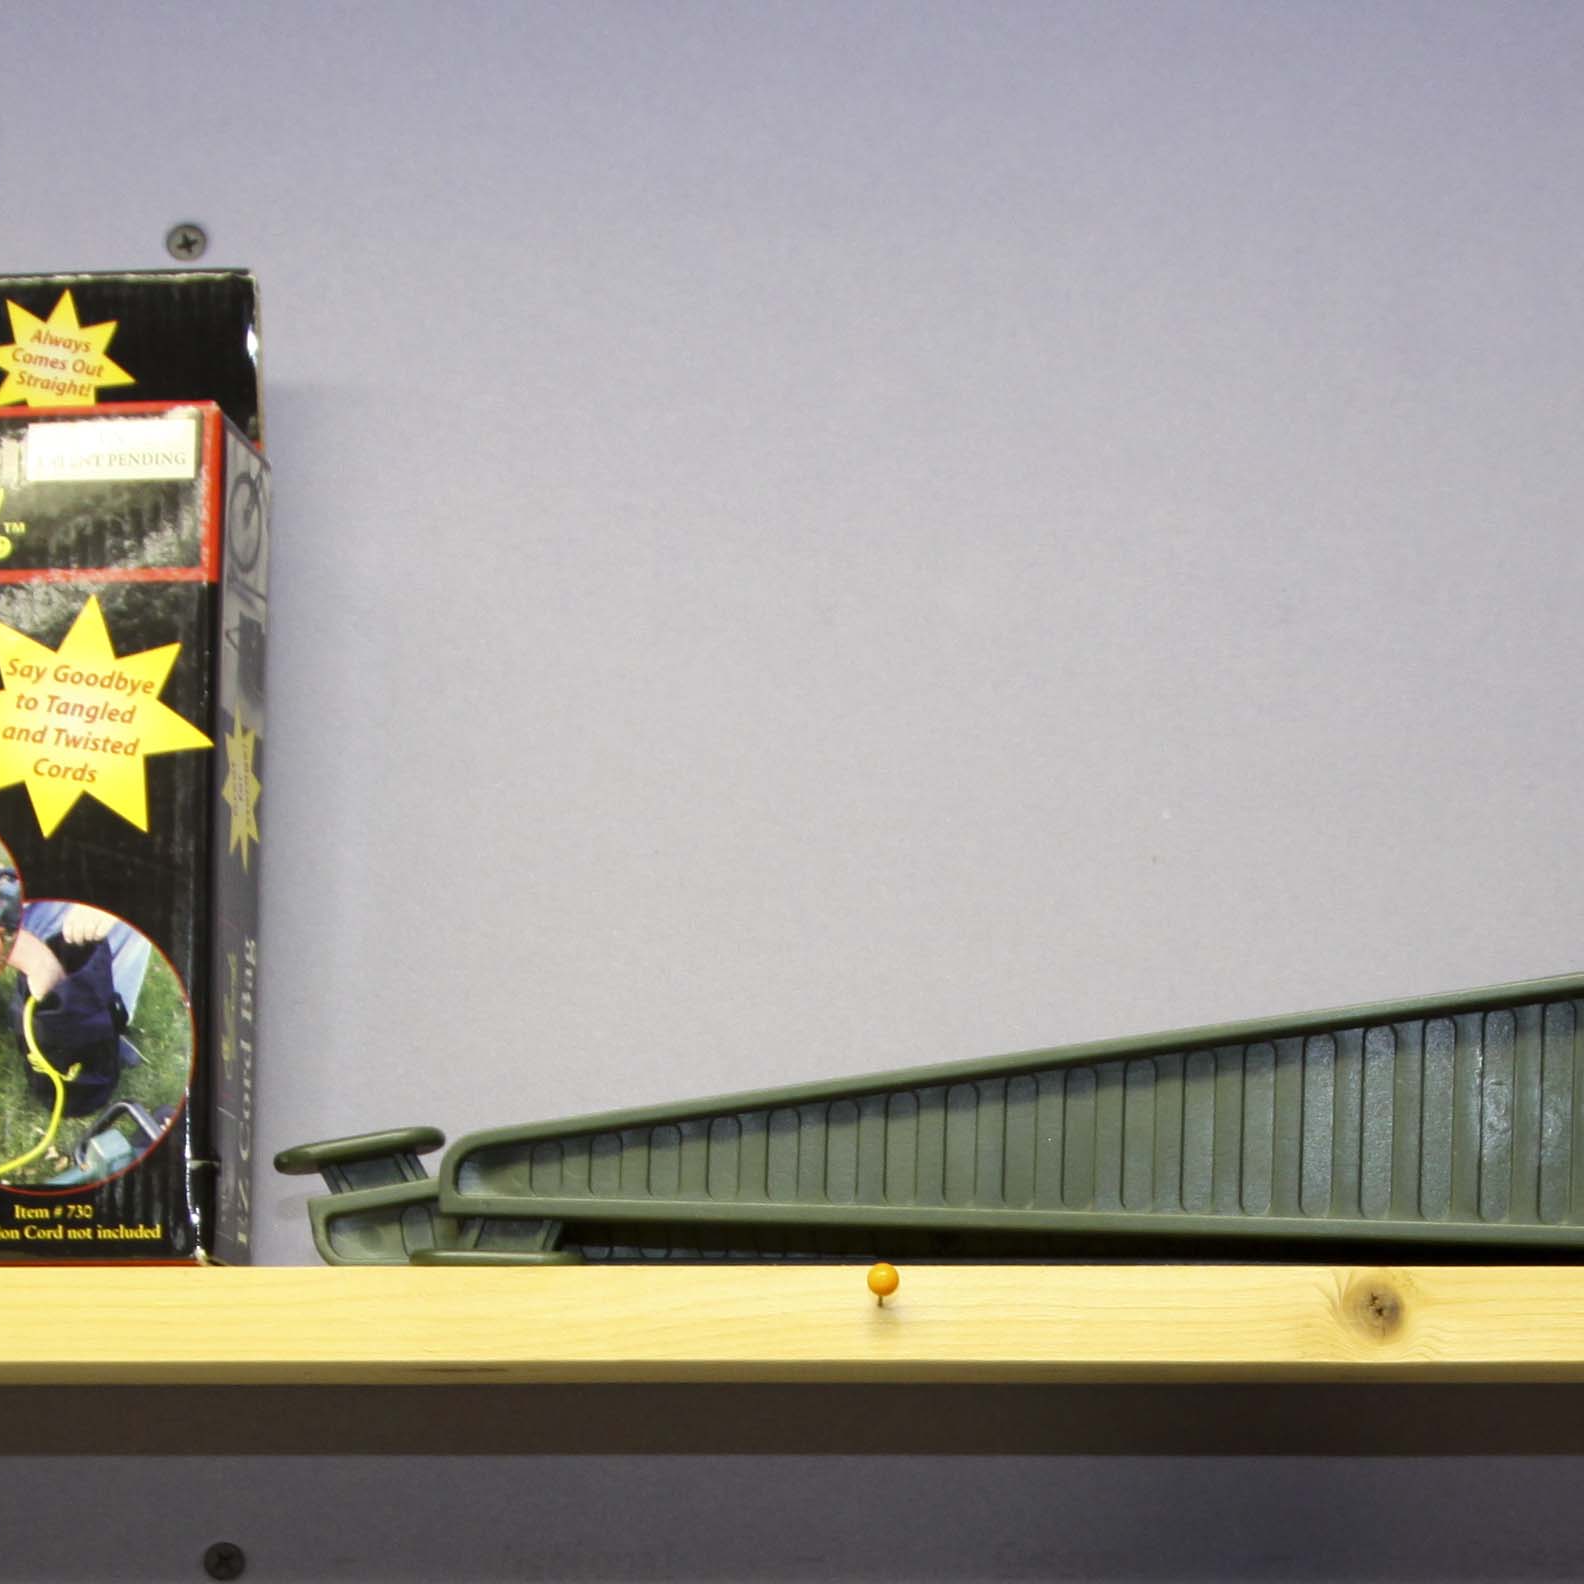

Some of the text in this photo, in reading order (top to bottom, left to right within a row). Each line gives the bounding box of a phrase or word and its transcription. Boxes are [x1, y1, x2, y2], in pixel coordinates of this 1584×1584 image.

[30, 329, 91, 353] Always
[11, 347, 104, 378] Comes Out
[16, 371, 92, 397] Straight!
[6, 658, 155, 697] Say Goodbye
[16, 692, 136, 726] to Tangled
[2, 724, 140, 757] and Twisted
[33, 758, 97, 784] Cords
[14, 1205, 93, 1220] Item # 730
[23, 1225, 63, 1240] Cord
[67, 1226, 93, 1240] not
[96, 1225, 161, 1240] included
